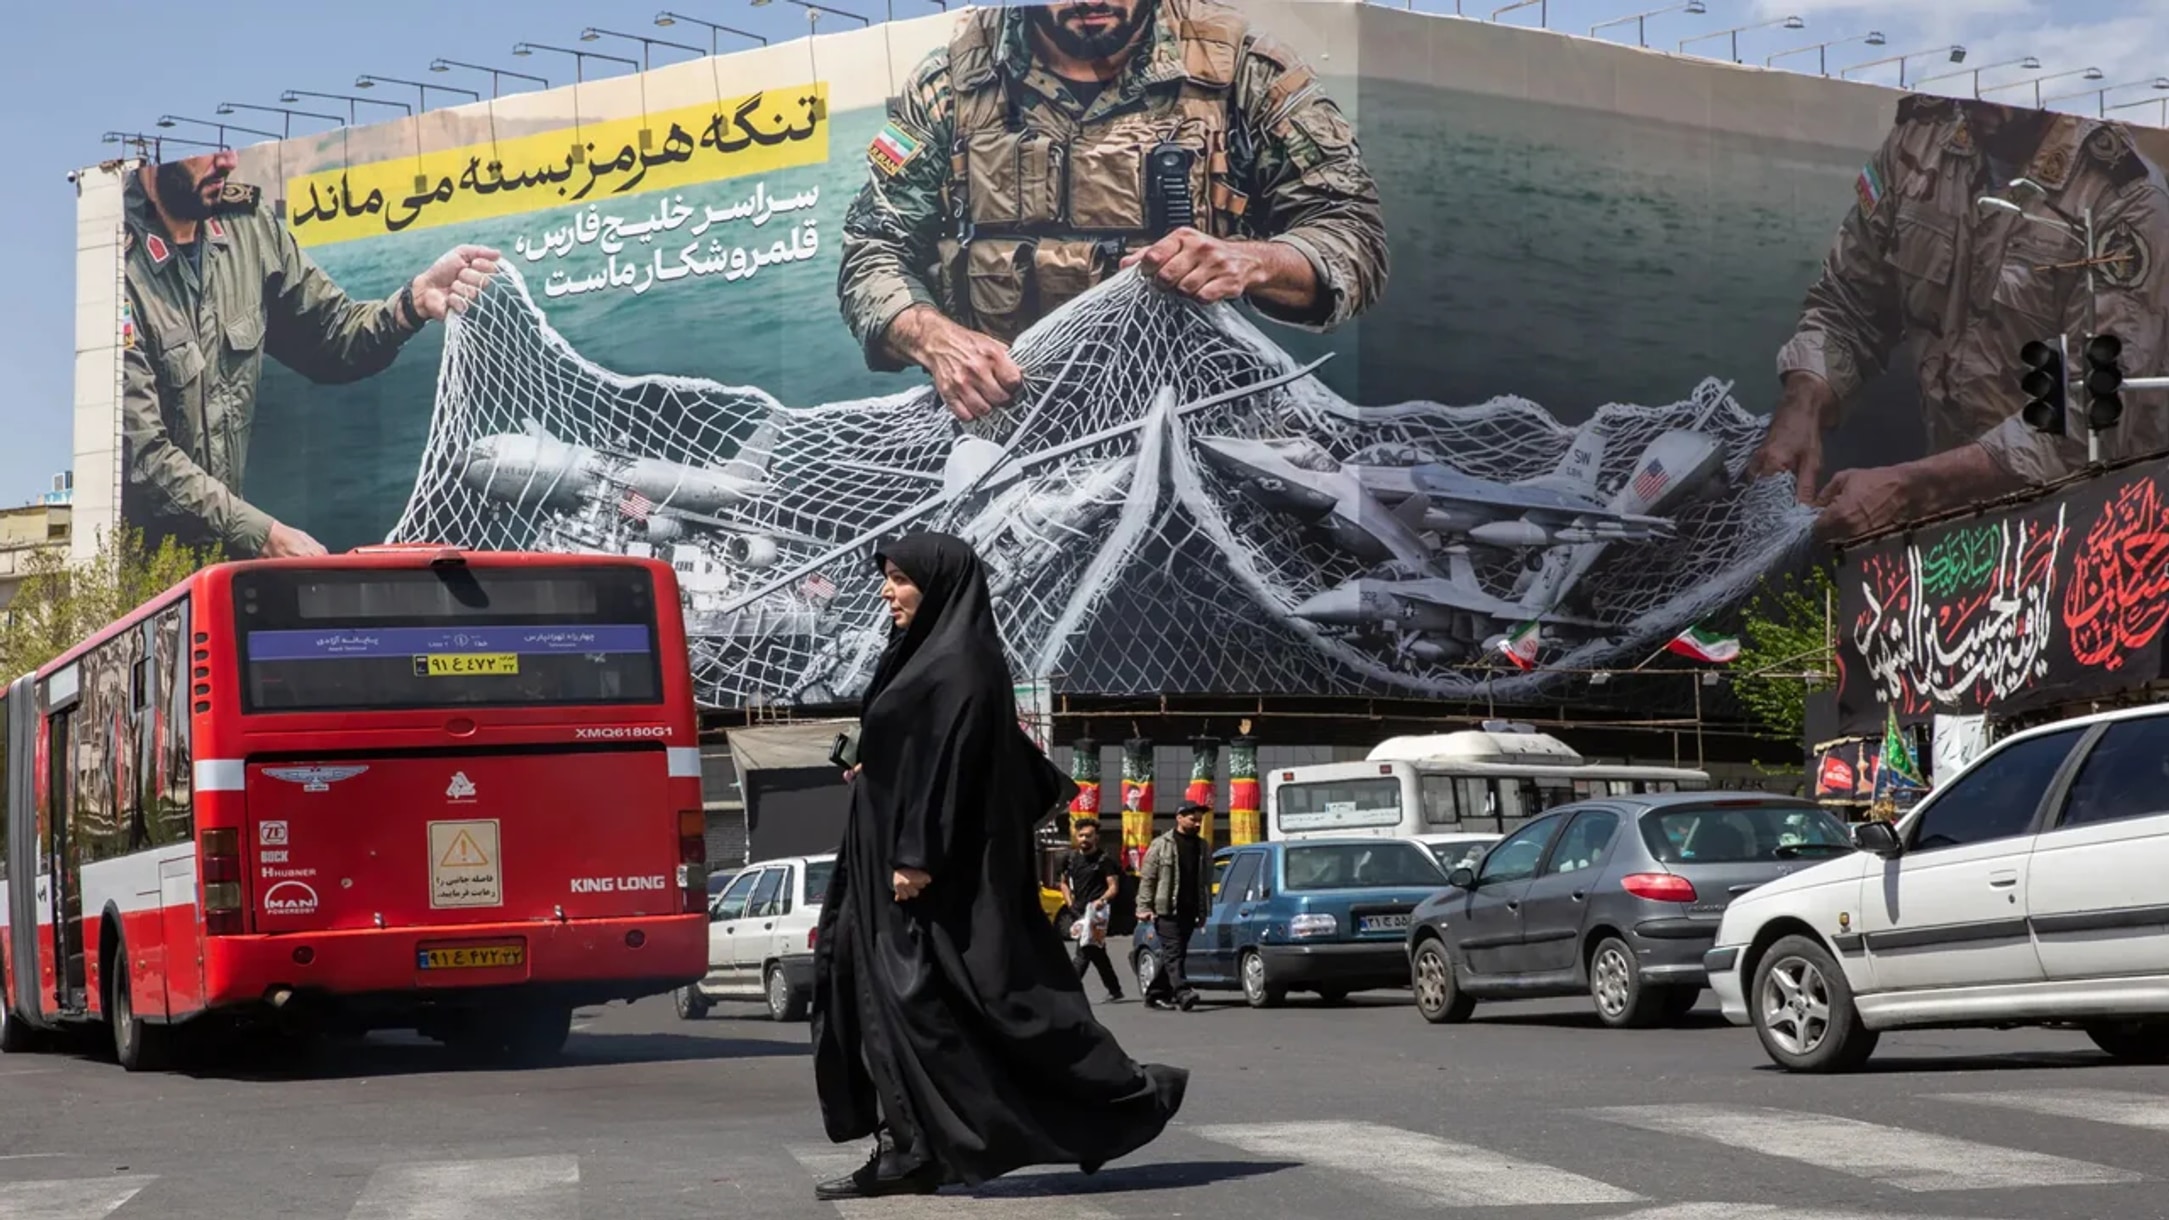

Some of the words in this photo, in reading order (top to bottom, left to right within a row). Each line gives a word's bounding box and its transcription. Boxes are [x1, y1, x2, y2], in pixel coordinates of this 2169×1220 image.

[700, 91, 818, 154] تنگه
[459, 150, 574, 197] بسته
[570, 123, 694, 201] هرمز
[600, 193, 695, 254] خلیج
[690, 181, 819, 235] سراسر
[632, 238, 729, 295] شکار
[724, 218, 819, 283] قلمرو
[544, 252, 636, 298] ماست
[1574, 448, 1593, 466] SW
[432, 658, 447, 671] ۹۱
[576, 727, 673, 739] XMQ6180G1
[269, 900, 313, 908] MAN
[571, 877, 614, 893] KING
[617, 876, 665, 891] LONG
[430, 951, 448, 965] ۹۱
